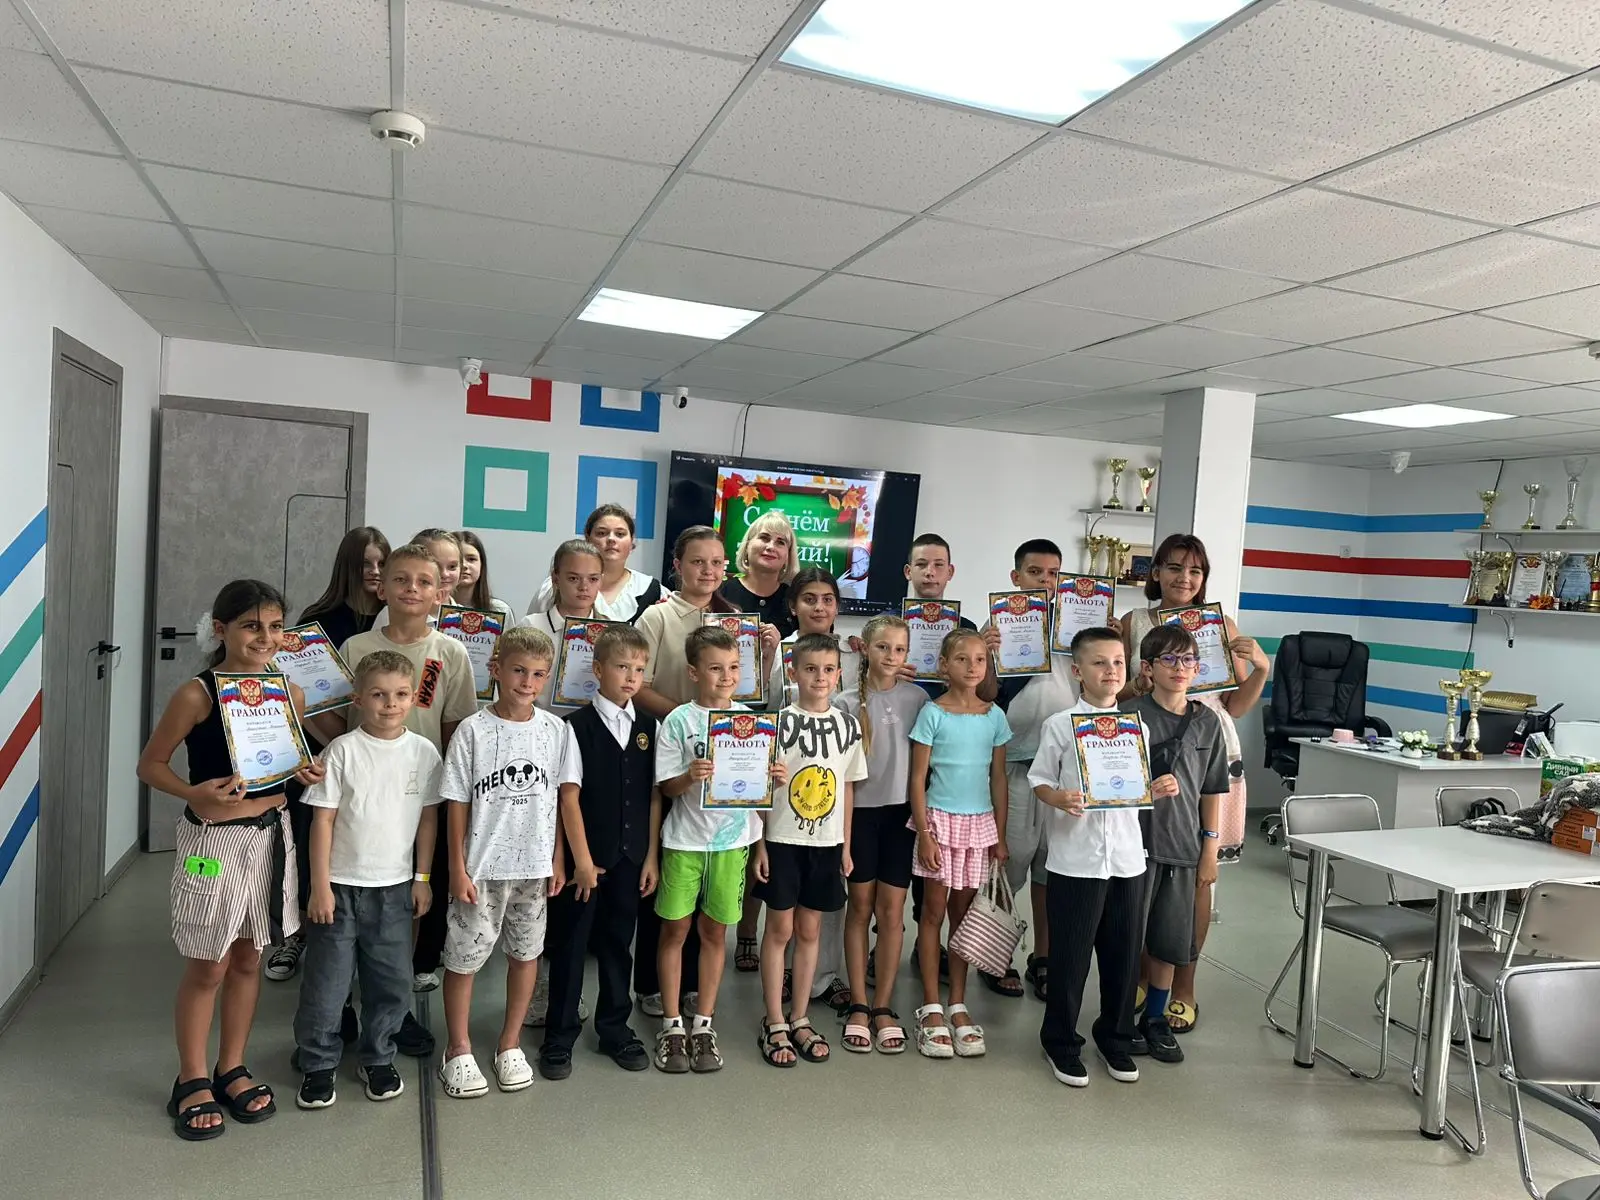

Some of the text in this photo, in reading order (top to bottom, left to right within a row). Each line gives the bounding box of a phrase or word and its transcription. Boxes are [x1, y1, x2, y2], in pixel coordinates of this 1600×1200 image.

[769, 508, 830, 532] нём
[1064, 597, 1105, 607] ГРАМОТА
[999, 615, 1040, 625] ГРАМОТА
[911, 623, 951, 631] ГРАМОТА
[447, 633, 491, 645] РАМОТА
[276, 648, 325, 664] ГРАМОТА
[231, 707, 281, 718] ГРАМОТА
[717, 740, 766, 748] ГРАМОТА
[1086, 739, 1135, 749] ГРАМОТА
[511, 798, 528, 806] 2025
